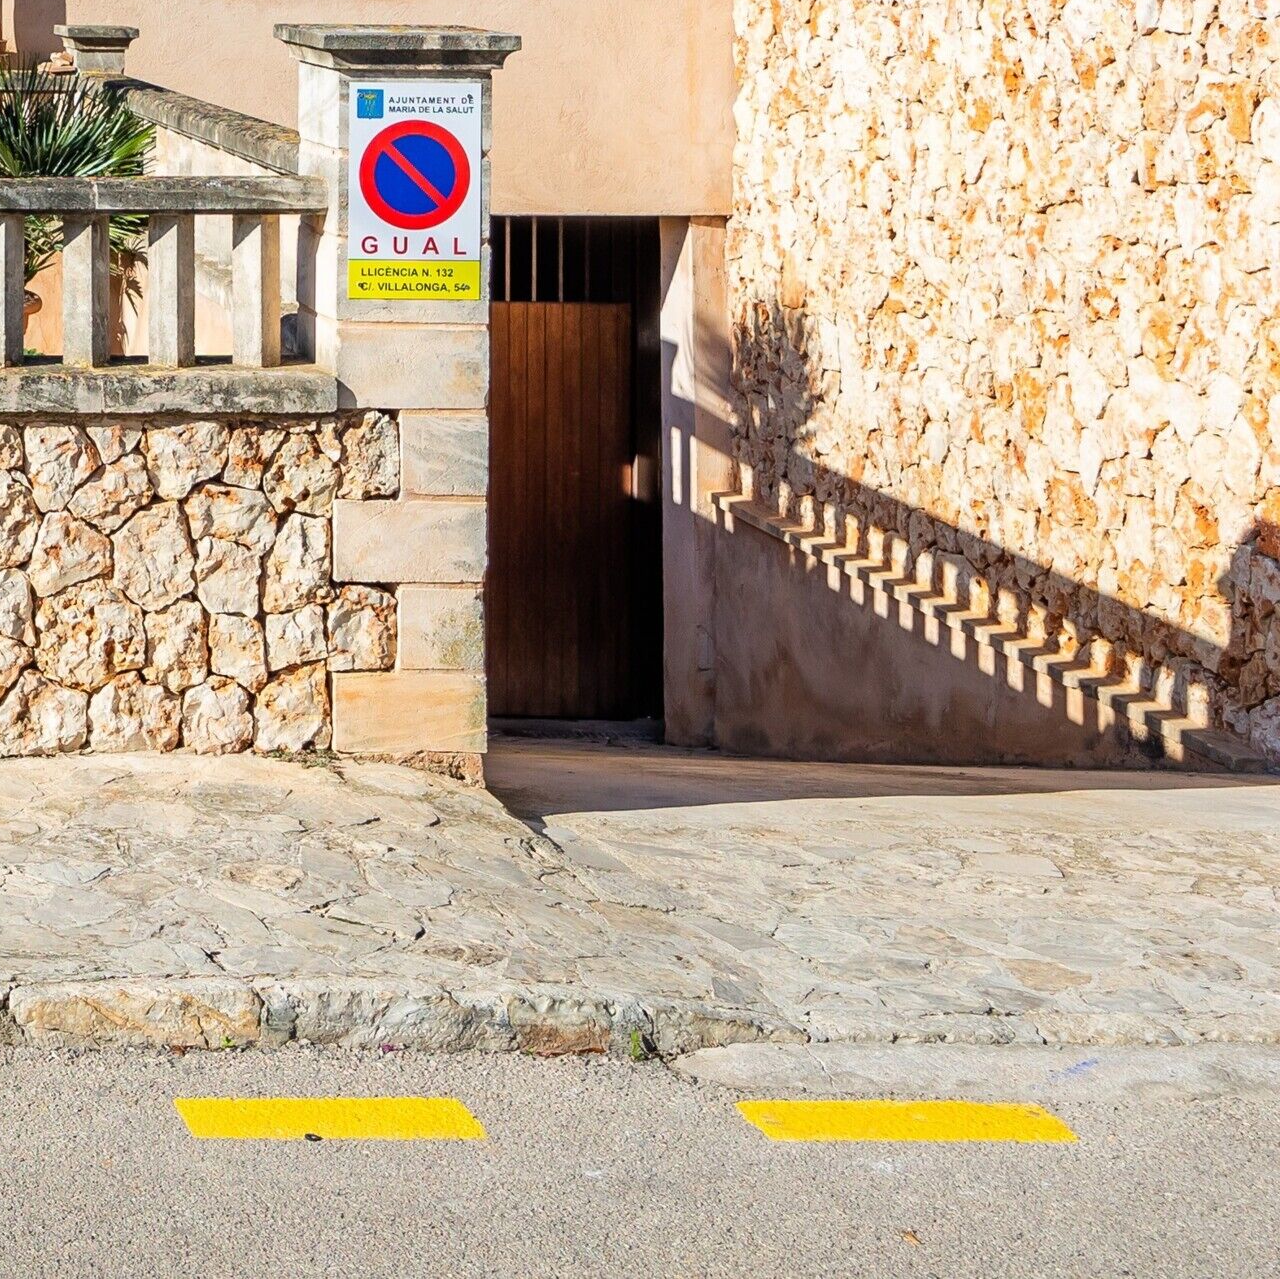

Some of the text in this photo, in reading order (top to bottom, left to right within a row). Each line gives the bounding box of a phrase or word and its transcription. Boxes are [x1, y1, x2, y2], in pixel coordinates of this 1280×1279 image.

[388, 96, 475, 105] AJUNTAMENT DE
[445, 106, 475, 114] SALUT
[361, 236, 467, 255] GUAL
[421, 268, 432, 277] N.
[436, 268, 454, 277] 132
[377, 282, 451, 293] VILLALONGA,
